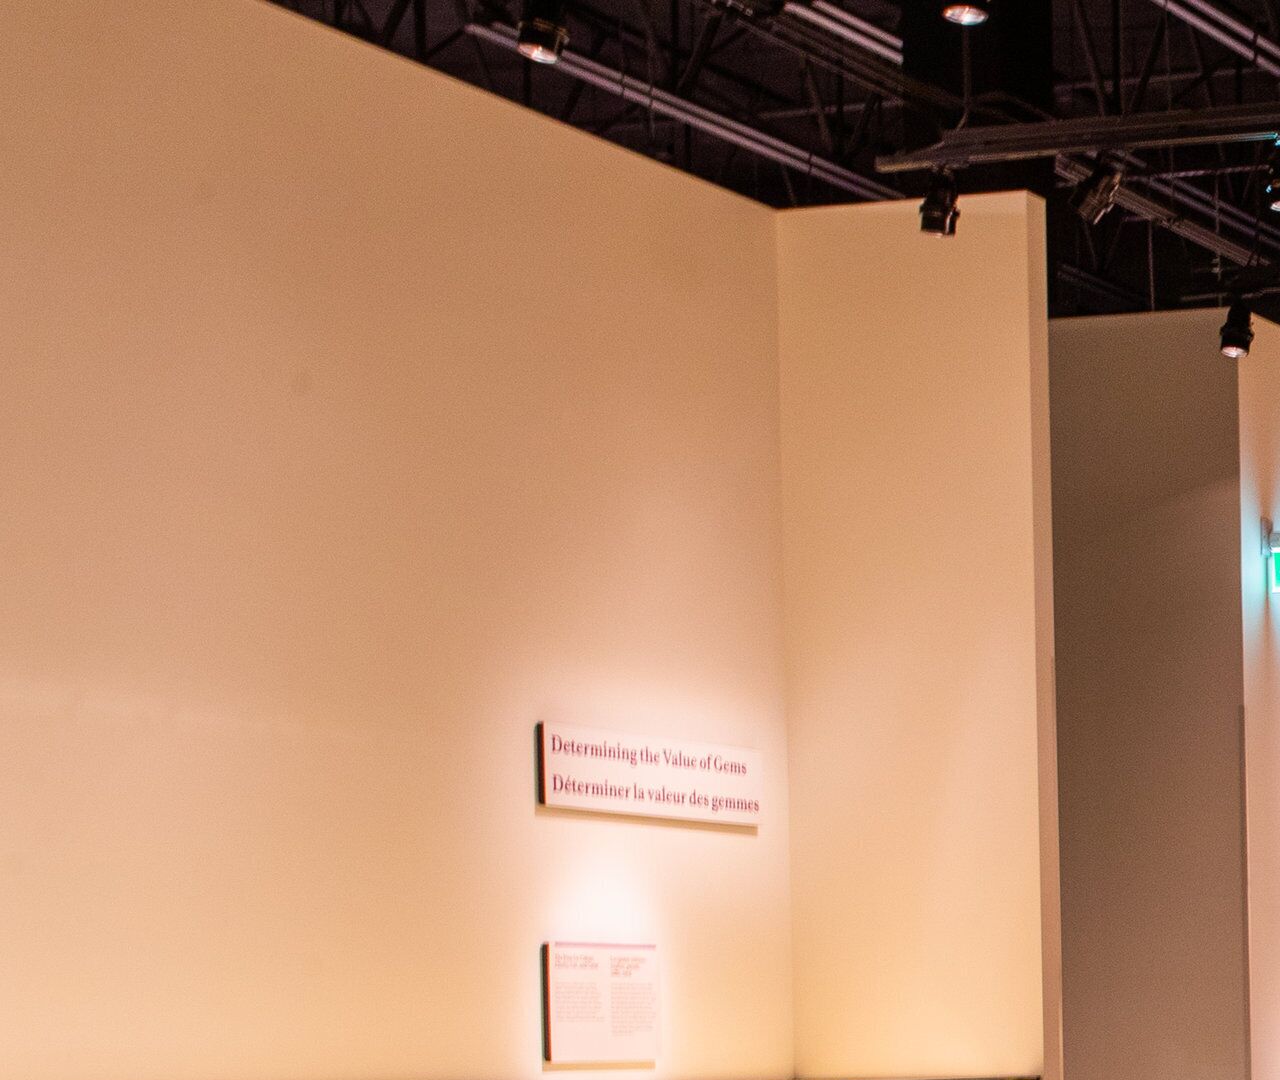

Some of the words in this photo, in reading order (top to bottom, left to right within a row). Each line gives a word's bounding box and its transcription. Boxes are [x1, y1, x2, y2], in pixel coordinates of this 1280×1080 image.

[551, 733, 638, 766] Determining
[640, 747, 661, 765] the
[663, 747, 697, 769] Value
[699, 754, 713, 769] of
[713, 755, 747, 775] Gems
[552, 773, 631, 800] Déterminer
[633, 782, 646, 800] la
[648, 785, 686, 805] valeur
[688, 790, 709, 807] des
[711, 795, 760, 813] gemmes
